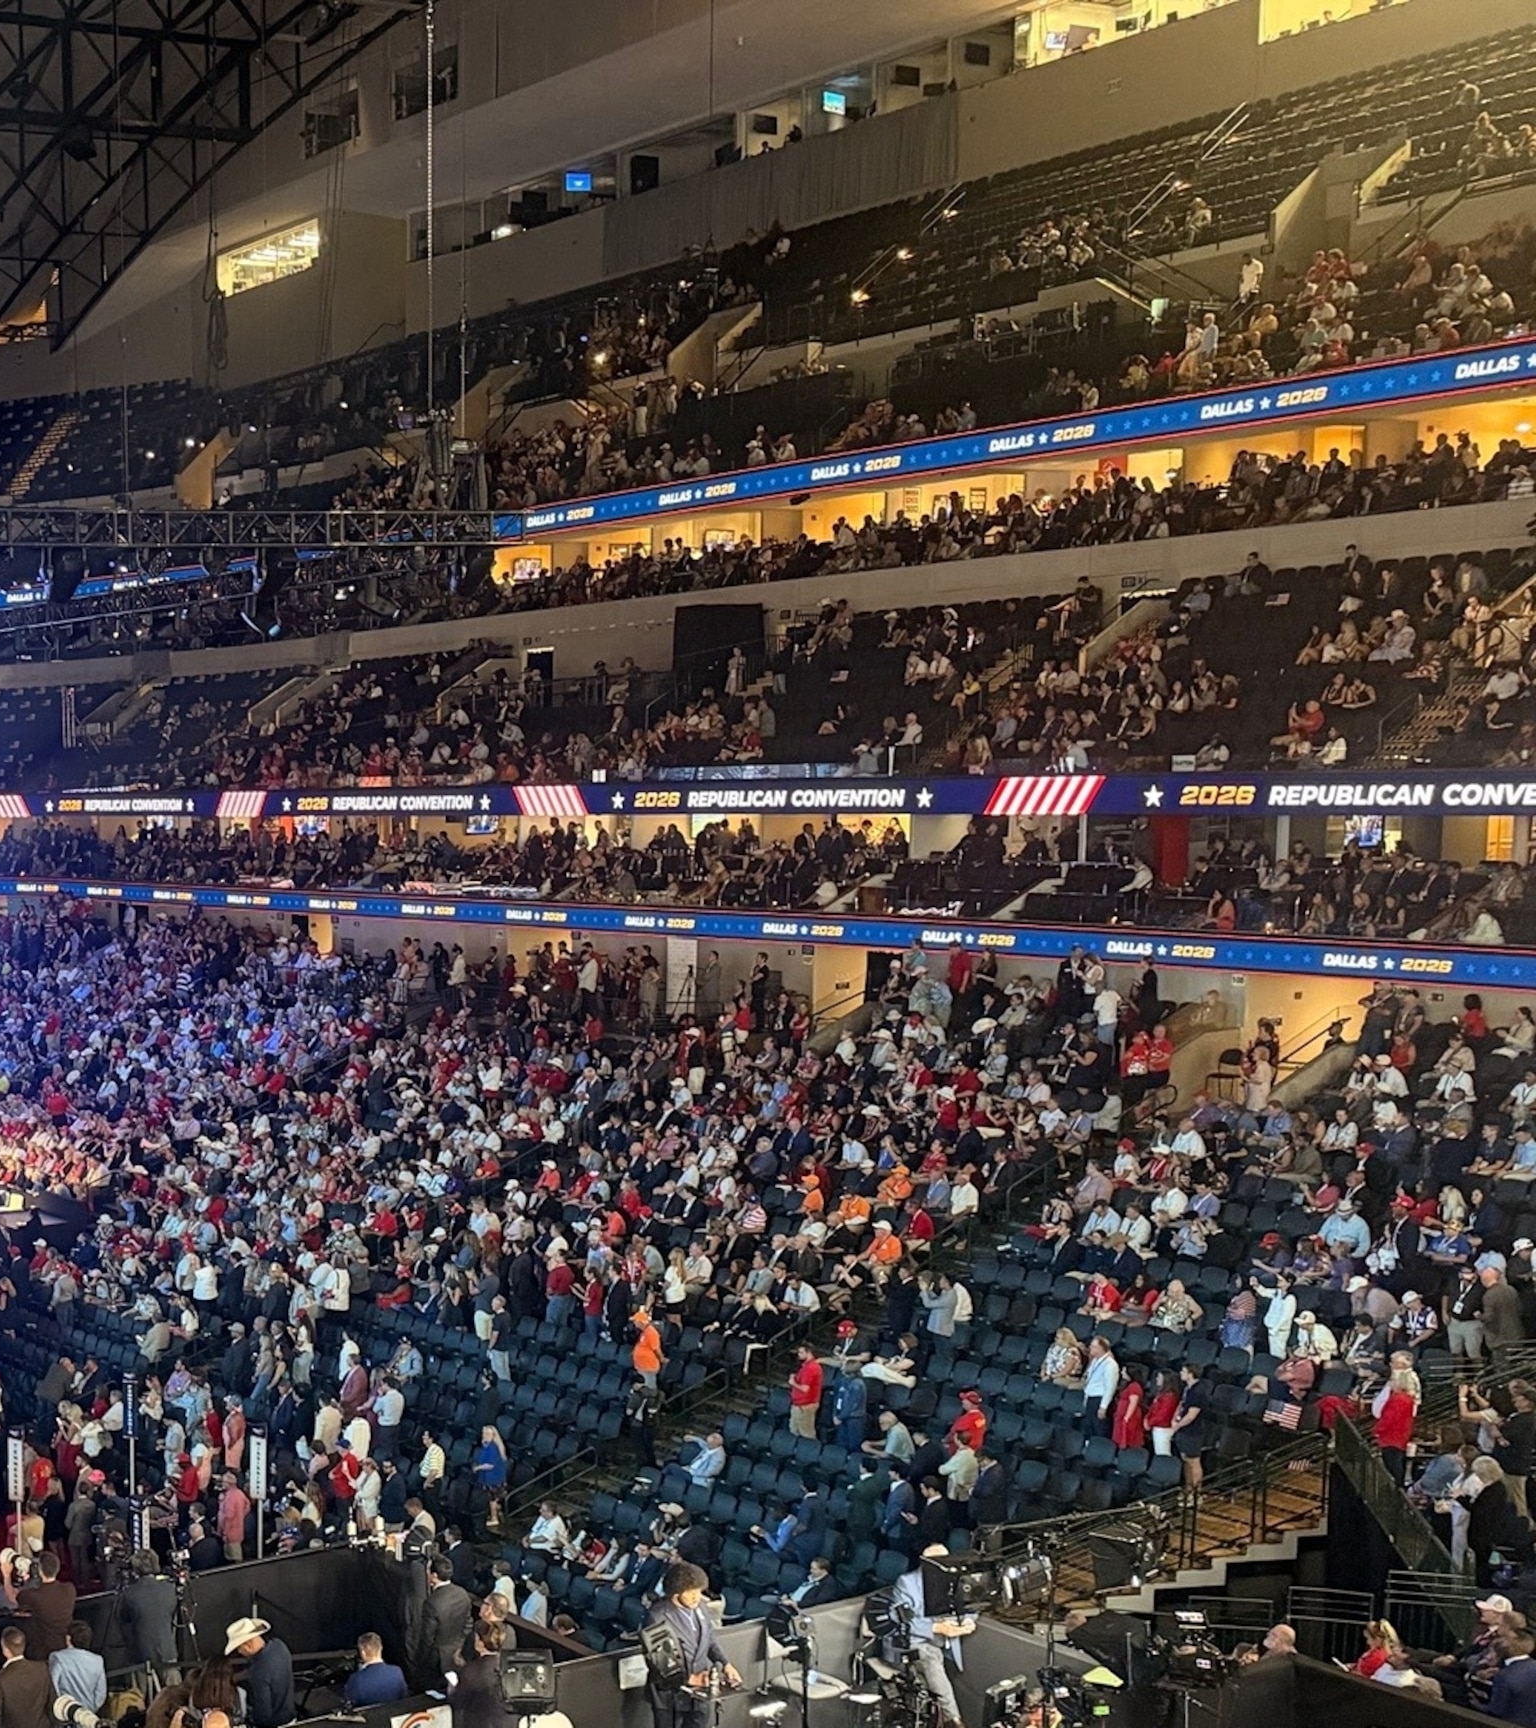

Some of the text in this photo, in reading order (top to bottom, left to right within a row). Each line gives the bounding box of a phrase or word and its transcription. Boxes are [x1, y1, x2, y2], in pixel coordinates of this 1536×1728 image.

[1455, 355, 1521, 380] DALLAS
[1200, 386, 1328, 419] DALLAS 2026
[989, 424, 1096, 453] DALLAS 2026
[811, 455, 901, 481] DALLAS 2026
[658, 482, 736, 506] DALLAS 2026
[526, 507, 594, 528] DALLAS 2026
[58, 798, 183, 812] 2026 REPUBLICAN CONVENTION
[297, 794, 473, 811] 2026 REPUBLICAN CONVENTION
[634, 788, 906, 808] 2026 REPUBLICAN CONVENTION
[1179, 785, 1257, 805] 2026
[1268, 784, 1435, 806] REPUBLICAN
[402, 904, 425, 915] DALLAS
[506, 909, 532, 920] DALLAS
[625, 915, 695, 929] DALLAS 2026
[763, 922, 844, 937] DALLAS 2026
[921, 930, 1016, 947] DALLAS 2026
[1106, 940, 1216, 959] DALLAS 2026
[1322, 953, 1453, 973] DALLAS 2026
